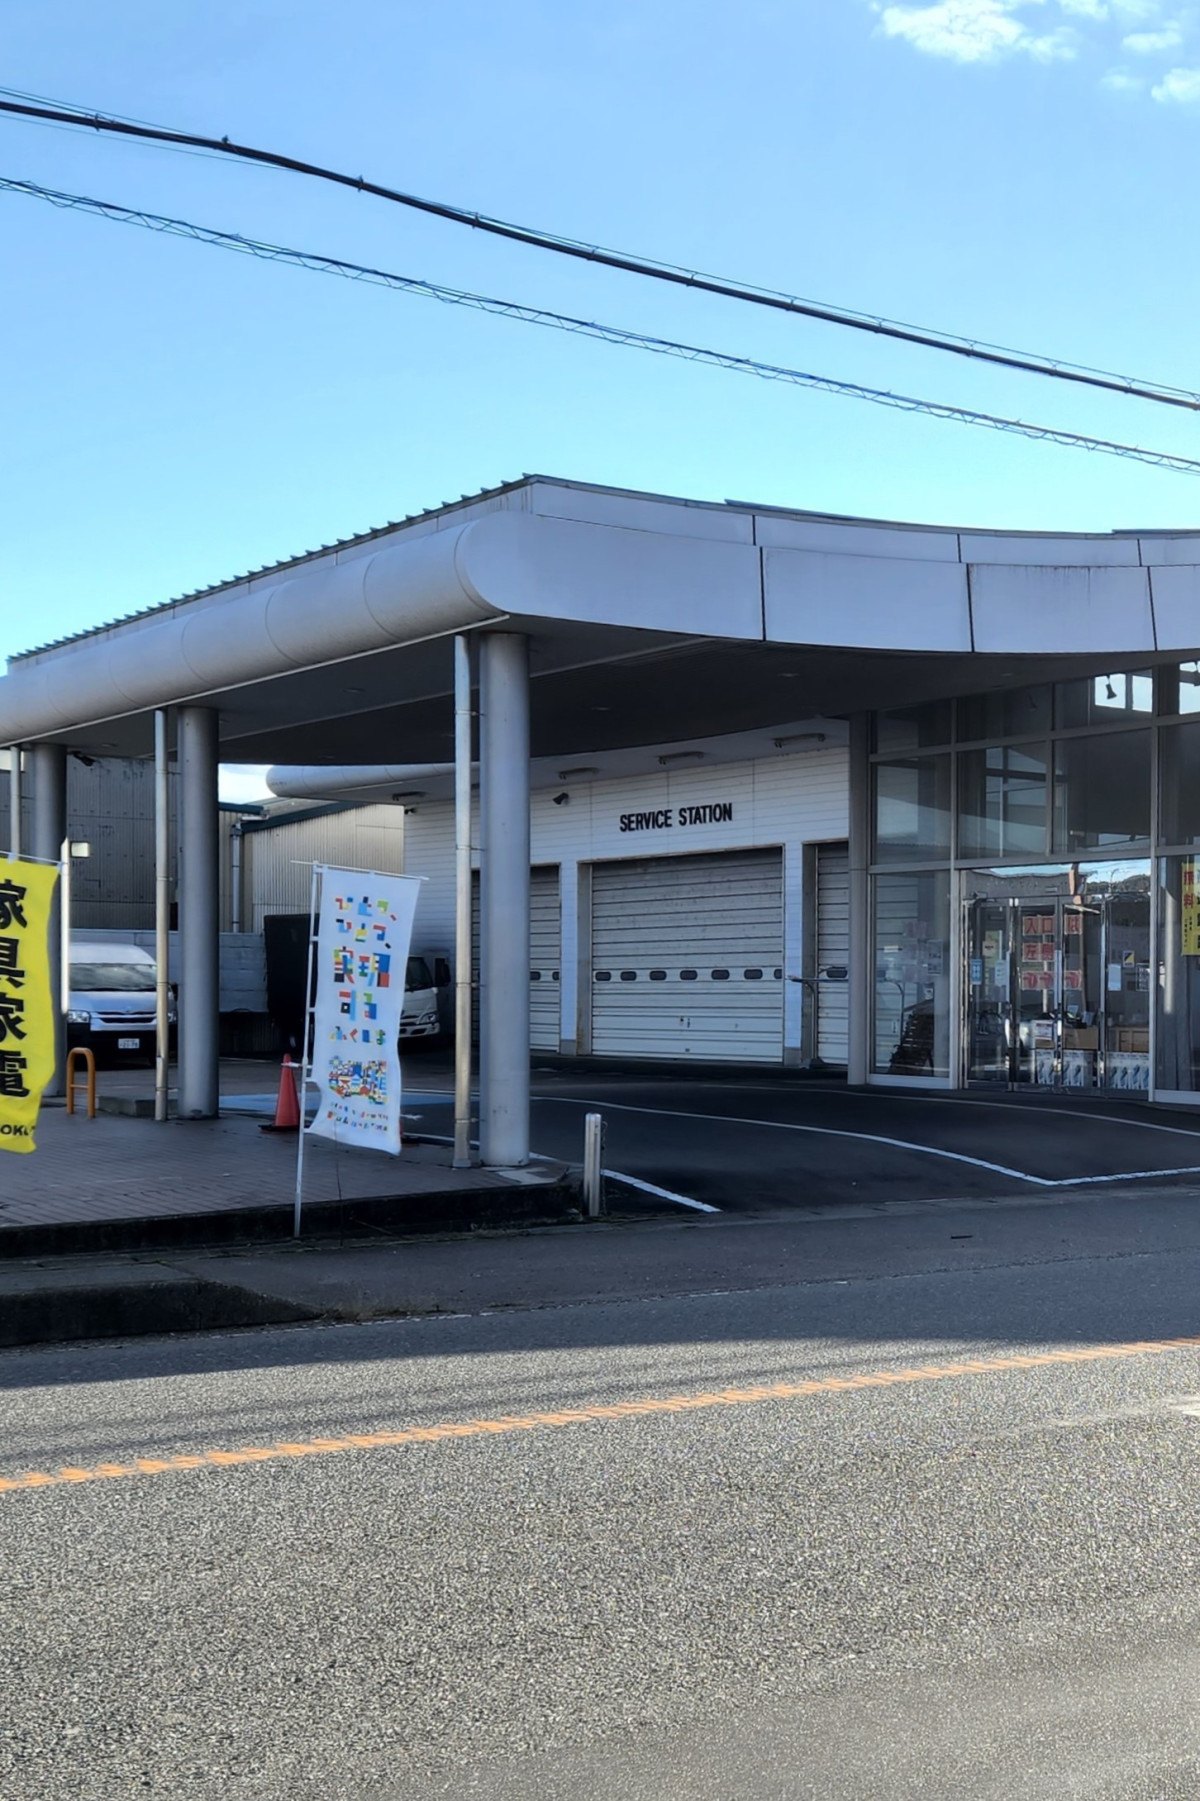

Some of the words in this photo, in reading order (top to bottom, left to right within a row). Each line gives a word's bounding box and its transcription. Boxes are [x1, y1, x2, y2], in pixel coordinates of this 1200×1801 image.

[619, 809, 673, 832] SERVICE
[678, 802, 732, 826] STATION
[0, 878, 30, 1098] 家具家電
